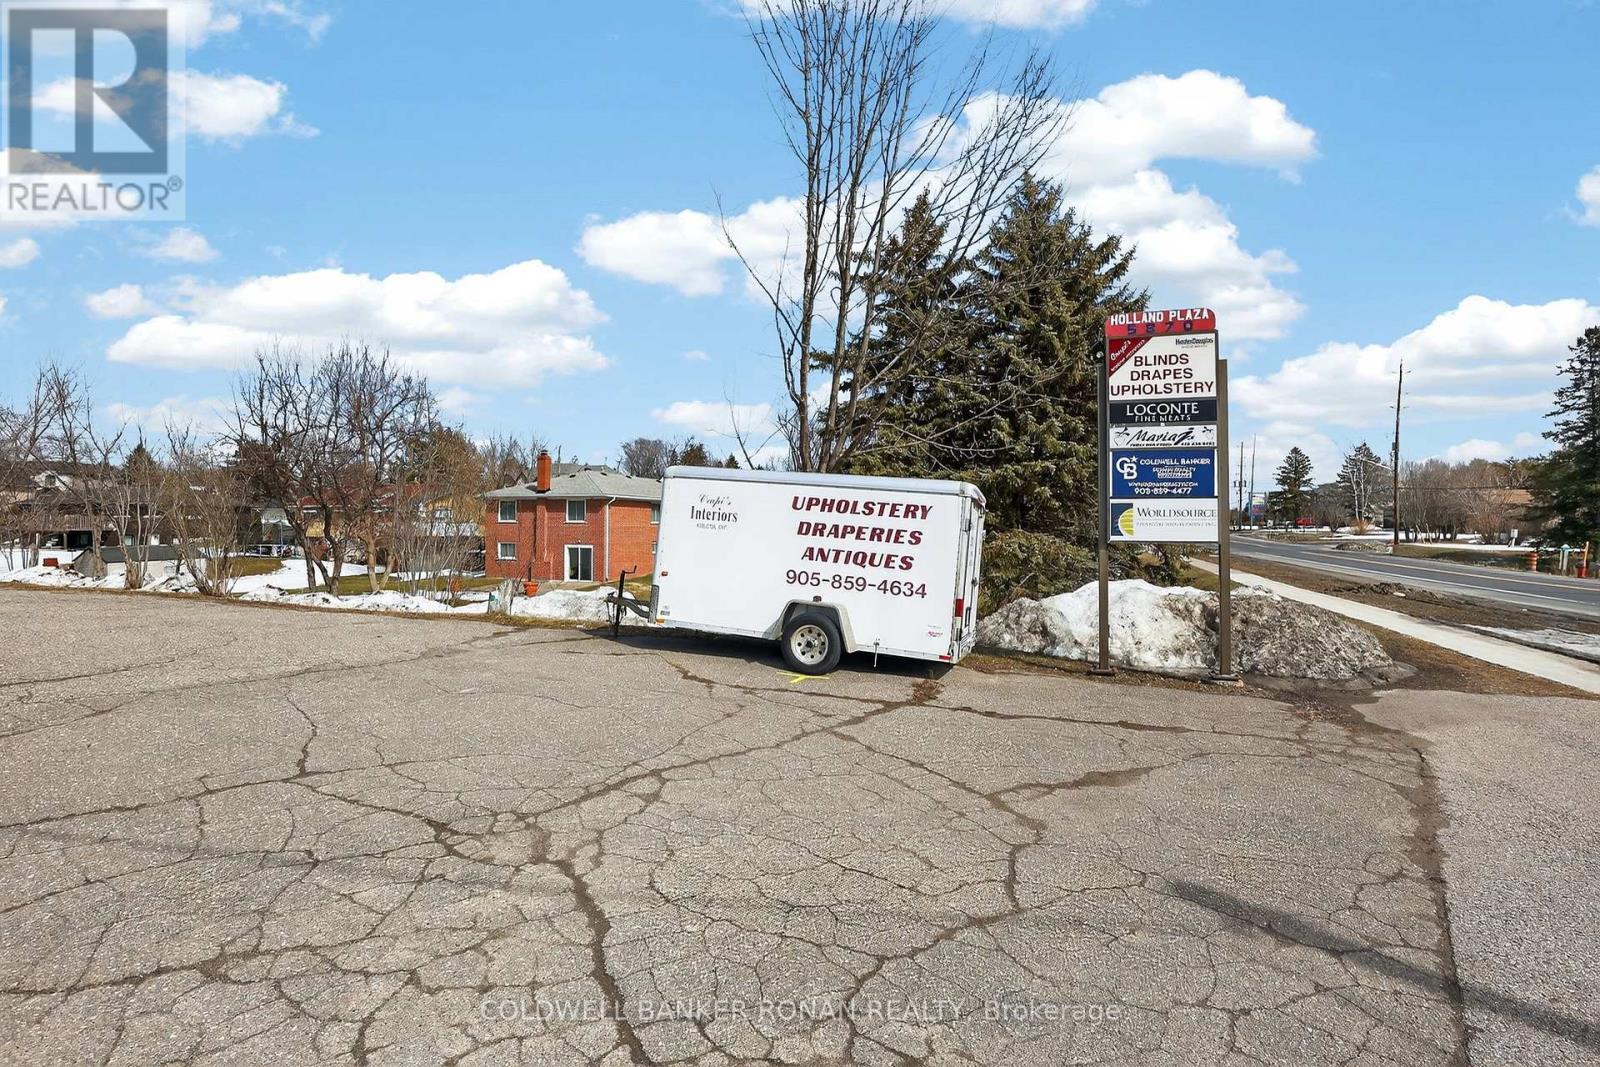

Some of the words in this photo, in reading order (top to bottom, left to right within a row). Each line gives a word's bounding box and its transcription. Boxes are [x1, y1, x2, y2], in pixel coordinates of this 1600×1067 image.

[1110, 311, 1164, 326] HOLLAND
[1168, 308, 1209, 321] PLAZA
[1133, 353, 1189, 367] BLINDS
[1130, 368, 1193, 382] DRAPES
[1110, 381, 1214, 396] UPHOLSTERY
[1126, 402, 1199, 416] LOCONTE
[1135, 415, 1156, 423] FINE
[1159, 414, 1191, 422] MEATS
[1139, 458, 1179, 466] COLDWELL
[1180, 457, 1211, 465] BANKER
[690, 505, 739, 523] Interiors
[791, 495, 934, 520] UPHOLSTERY
[1137, 507, 1216, 518] WORLDSOURCE
[797, 521, 923, 546] DRAPERIES
[801, 546, 915, 571] ANTIQUES
[786, 569, 928, 599] 905-859-4634
